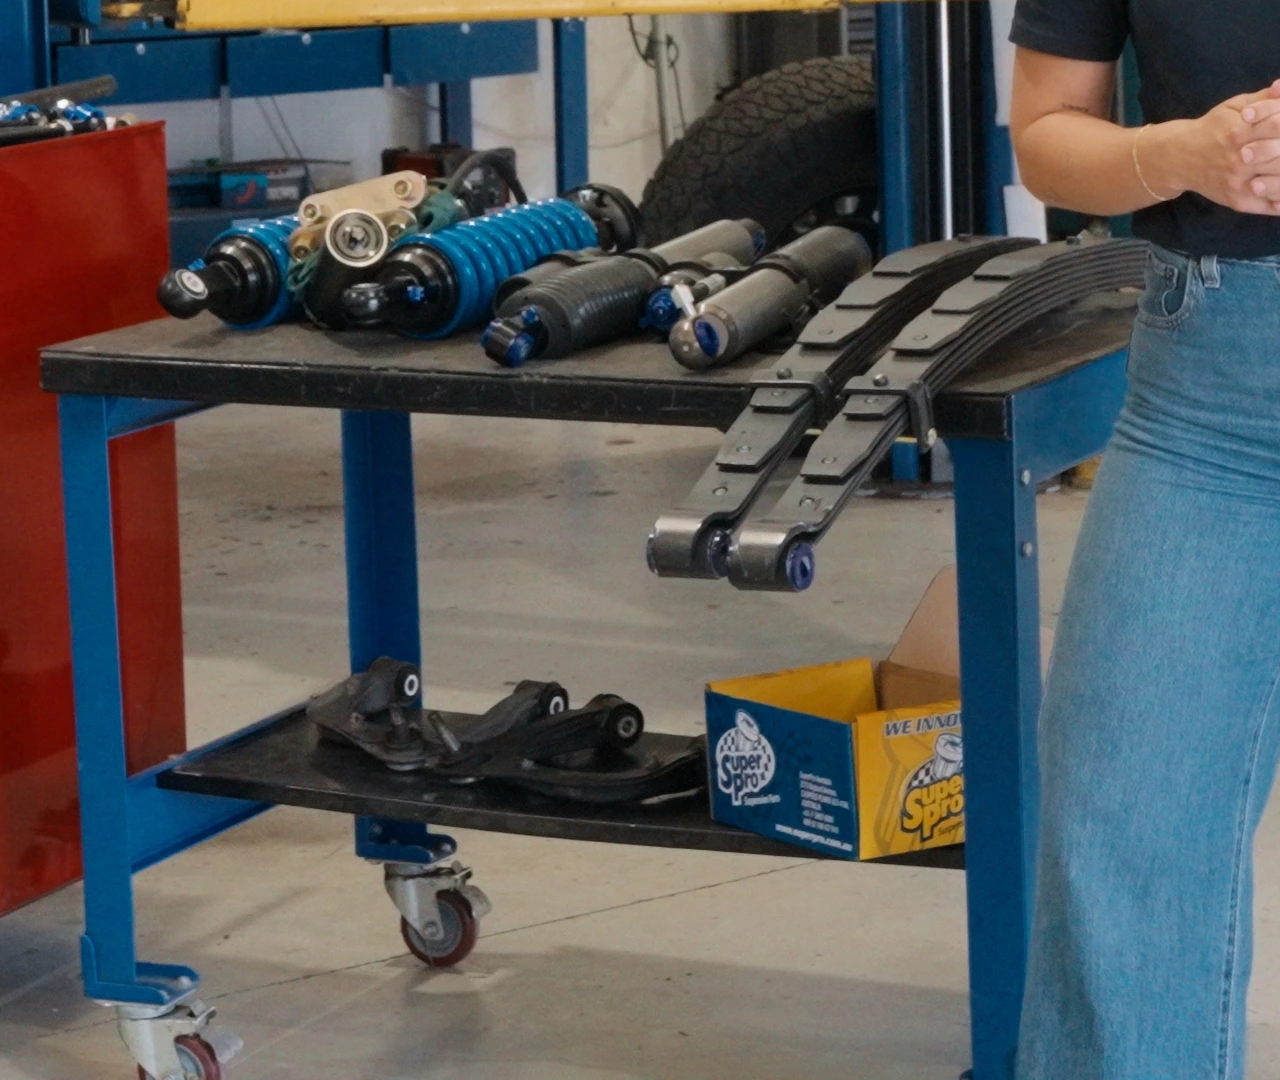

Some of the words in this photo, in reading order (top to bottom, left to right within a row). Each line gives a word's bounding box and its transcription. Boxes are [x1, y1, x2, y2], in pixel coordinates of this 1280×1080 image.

[885, 720, 912, 736] WE
[916, 712, 961, 732] INNO
[903, 775, 963, 829] Supe
